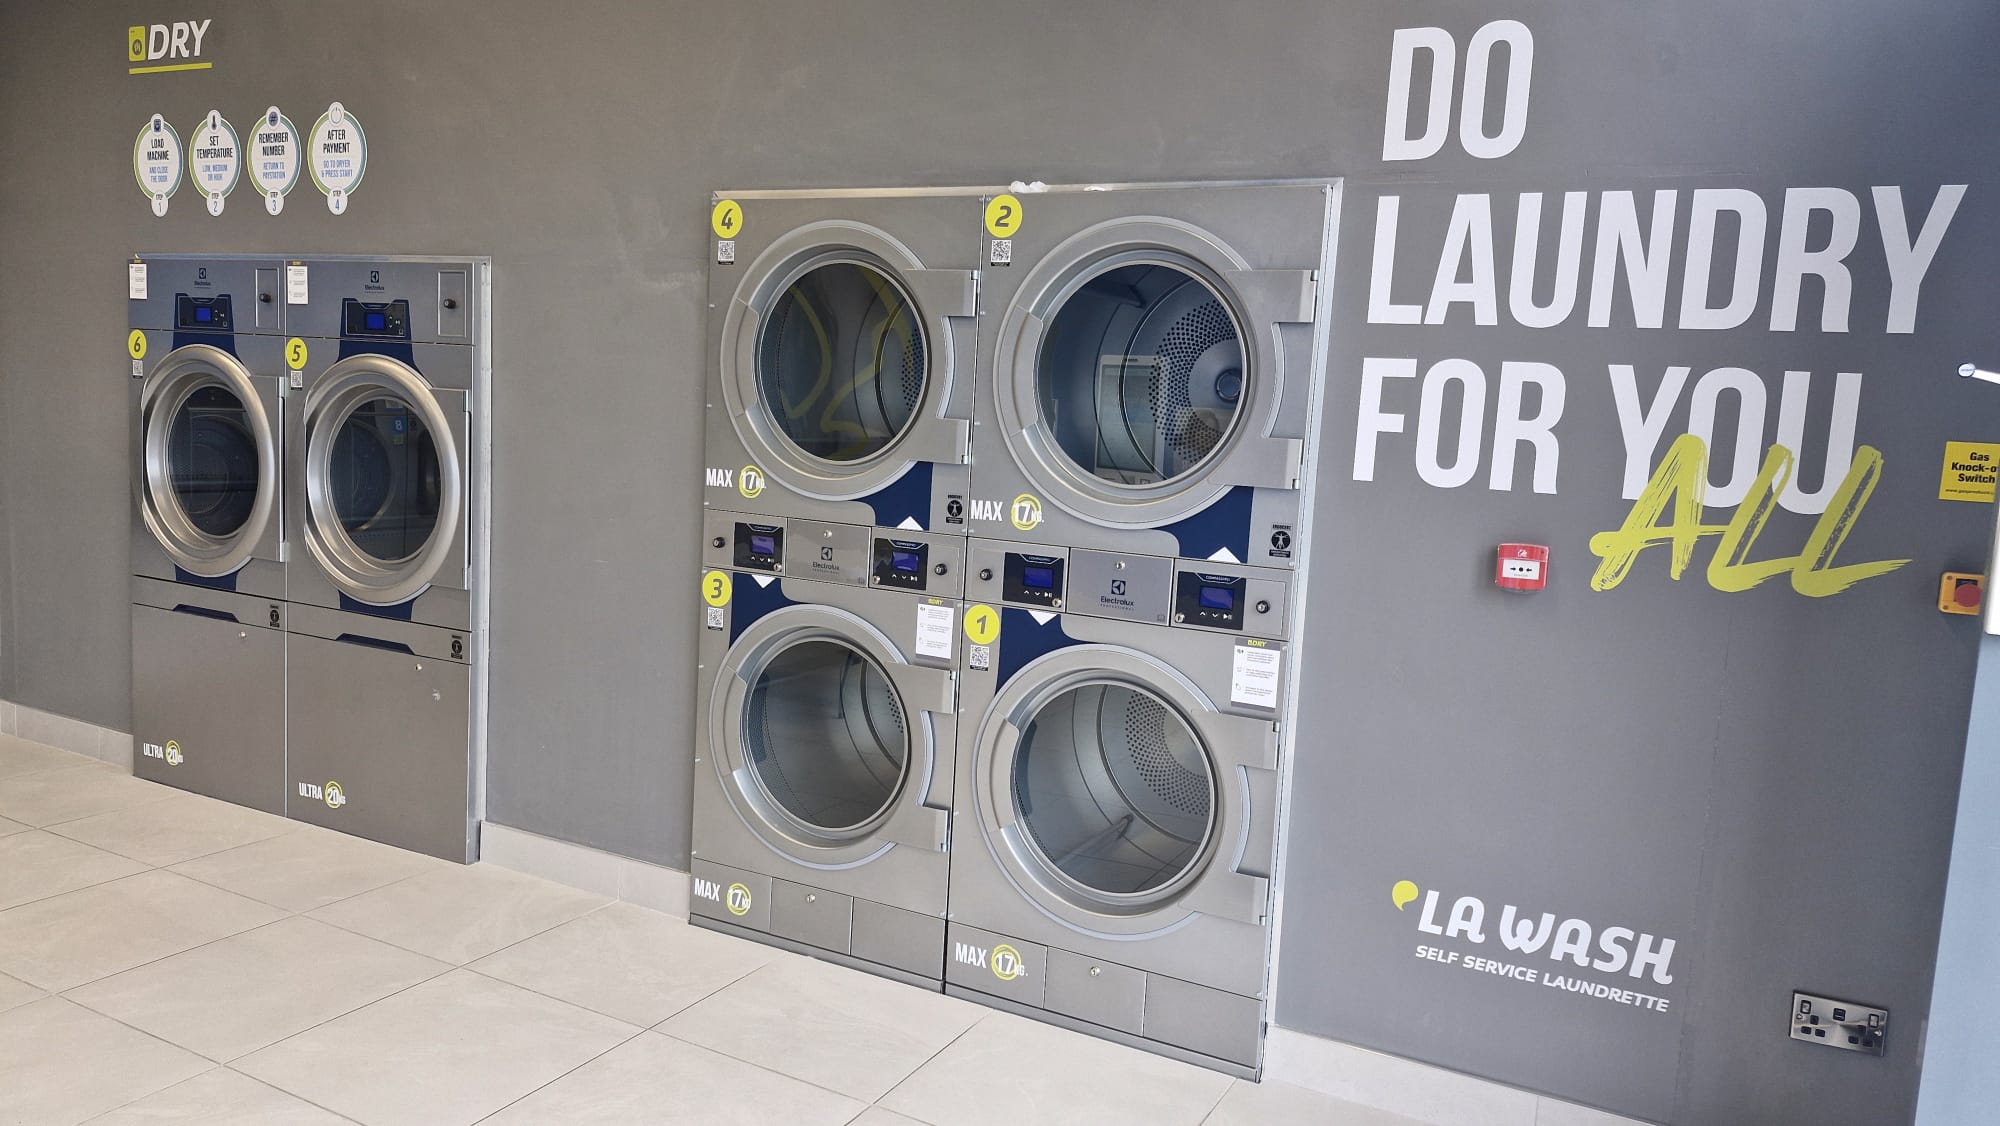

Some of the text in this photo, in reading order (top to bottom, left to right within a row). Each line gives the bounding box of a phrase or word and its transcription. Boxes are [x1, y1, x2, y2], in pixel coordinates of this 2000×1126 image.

[148, 19, 211, 60] DRY
[1382, 19, 1534, 161] DO
[151, 138, 164, 148] LOAD
[209, 135, 219, 146] SET
[258, 132, 289, 144] REMEMBER
[327, 129, 346, 140] AFTER
[146, 150, 169, 161] MACHINE
[196, 147, 233, 160] TEMPERATURE
[262, 145, 285, 156] NUMBER
[323, 142, 350, 154] PAYMENT
[325, 169, 339, 178] PRESS
[214, 201, 218, 212] 2
[272, 200, 276, 212] 3
[335, 199, 340, 210] 4
[721, 208, 733, 230] 4
[995, 205, 1012, 228] 2
[1366, 184, 1968, 334] LAUNDRY
[134, 336, 141, 352] 6
[291, 344, 302, 362] 5
[1352, 357, 1863, 515] FOR YOU
[1970, 451, 1990, 462] Gas
[706, 468, 733, 488] MAX
[1958, 472, 1996, 484] Switch
[970, 500, 1003, 521] MAX
[1589, 433, 1913, 597] ALL
[812, 561, 840, 571] Electrolux
[711, 578, 723, 598] 3
[1100, 596, 1134, 606] Electrolux
[976, 614, 987, 634] 1
[143, 742, 164, 760] ULTRA
[298, 782, 323, 801] ULTRA
[694, 878, 720, 902] MAX
[1417, 889, 1676, 985] LA WASH
[955, 942, 987, 968] MAX
[1415, 944, 1670, 1013] SELF SERVICE LAUNDRETTE
